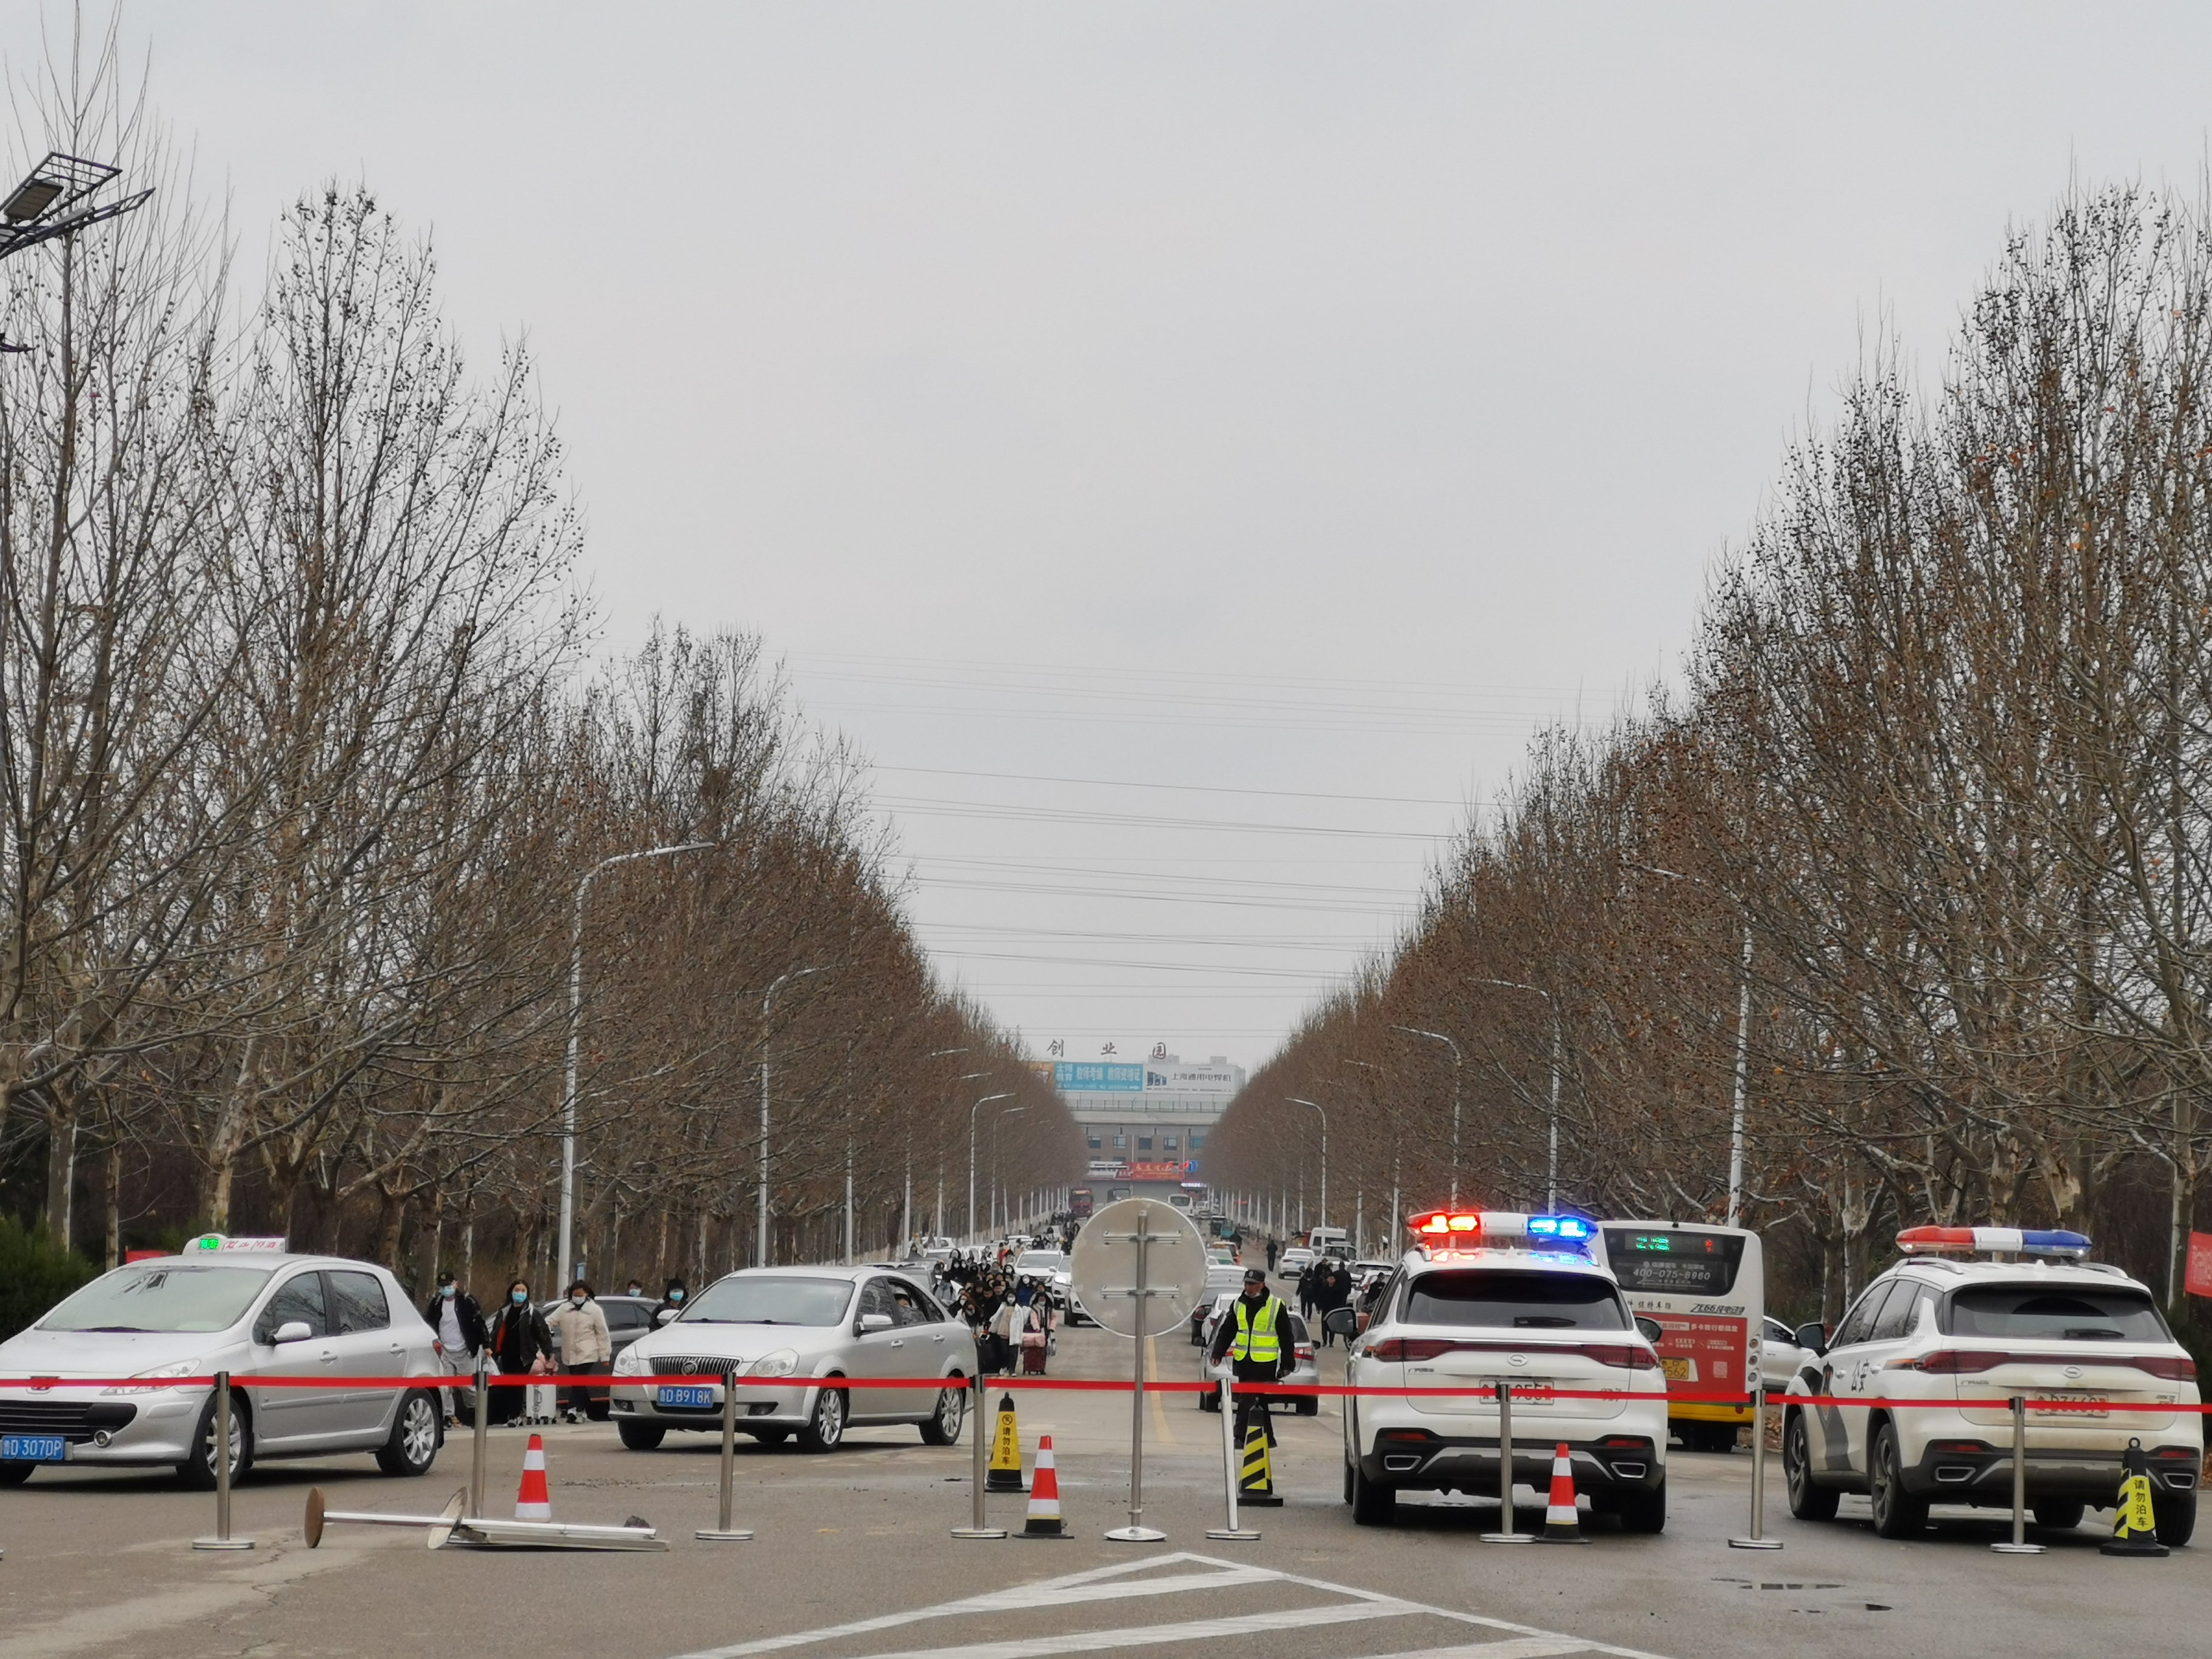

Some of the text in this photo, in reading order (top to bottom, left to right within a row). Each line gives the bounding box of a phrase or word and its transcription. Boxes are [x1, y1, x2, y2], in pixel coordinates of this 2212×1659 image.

[1046, 1039, 1166, 1059] 创业园
[1851, 1359, 1870, 1393] 公安
[1002, 1427, 1011, 1466] 请勿泊车
[2134, 1480, 2148, 1527] 请勿泊车
